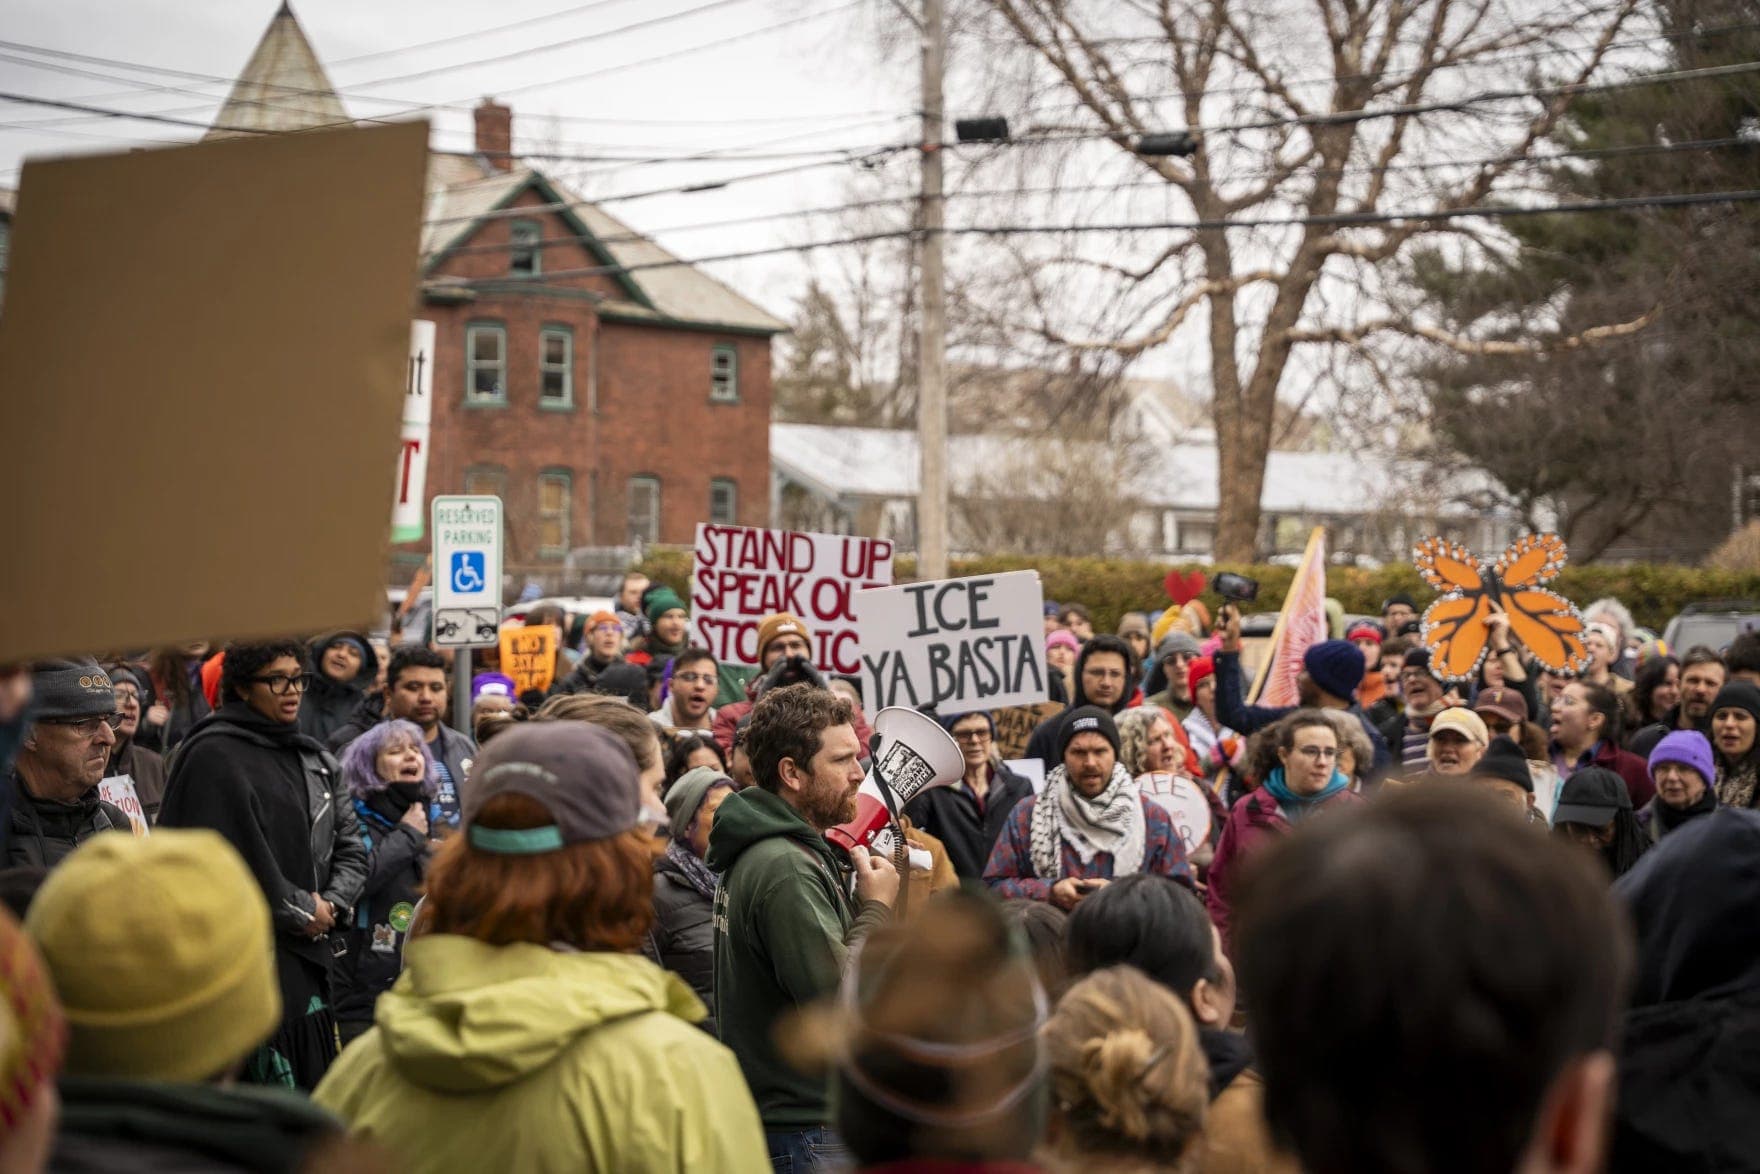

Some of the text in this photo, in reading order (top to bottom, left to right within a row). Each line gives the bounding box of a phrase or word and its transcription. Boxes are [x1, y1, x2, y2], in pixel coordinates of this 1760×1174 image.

[439, 509, 494, 523] RESERVED
[444, 530, 491, 544] PARKING
[697, 525, 891, 579] STAND UP
[694, 567, 889, 622] SPEAK OU
[904, 580, 1000, 637] ICE
[694, 616, 861, 674] STO IC
[862, 635, 1043, 709] YA BASTA
